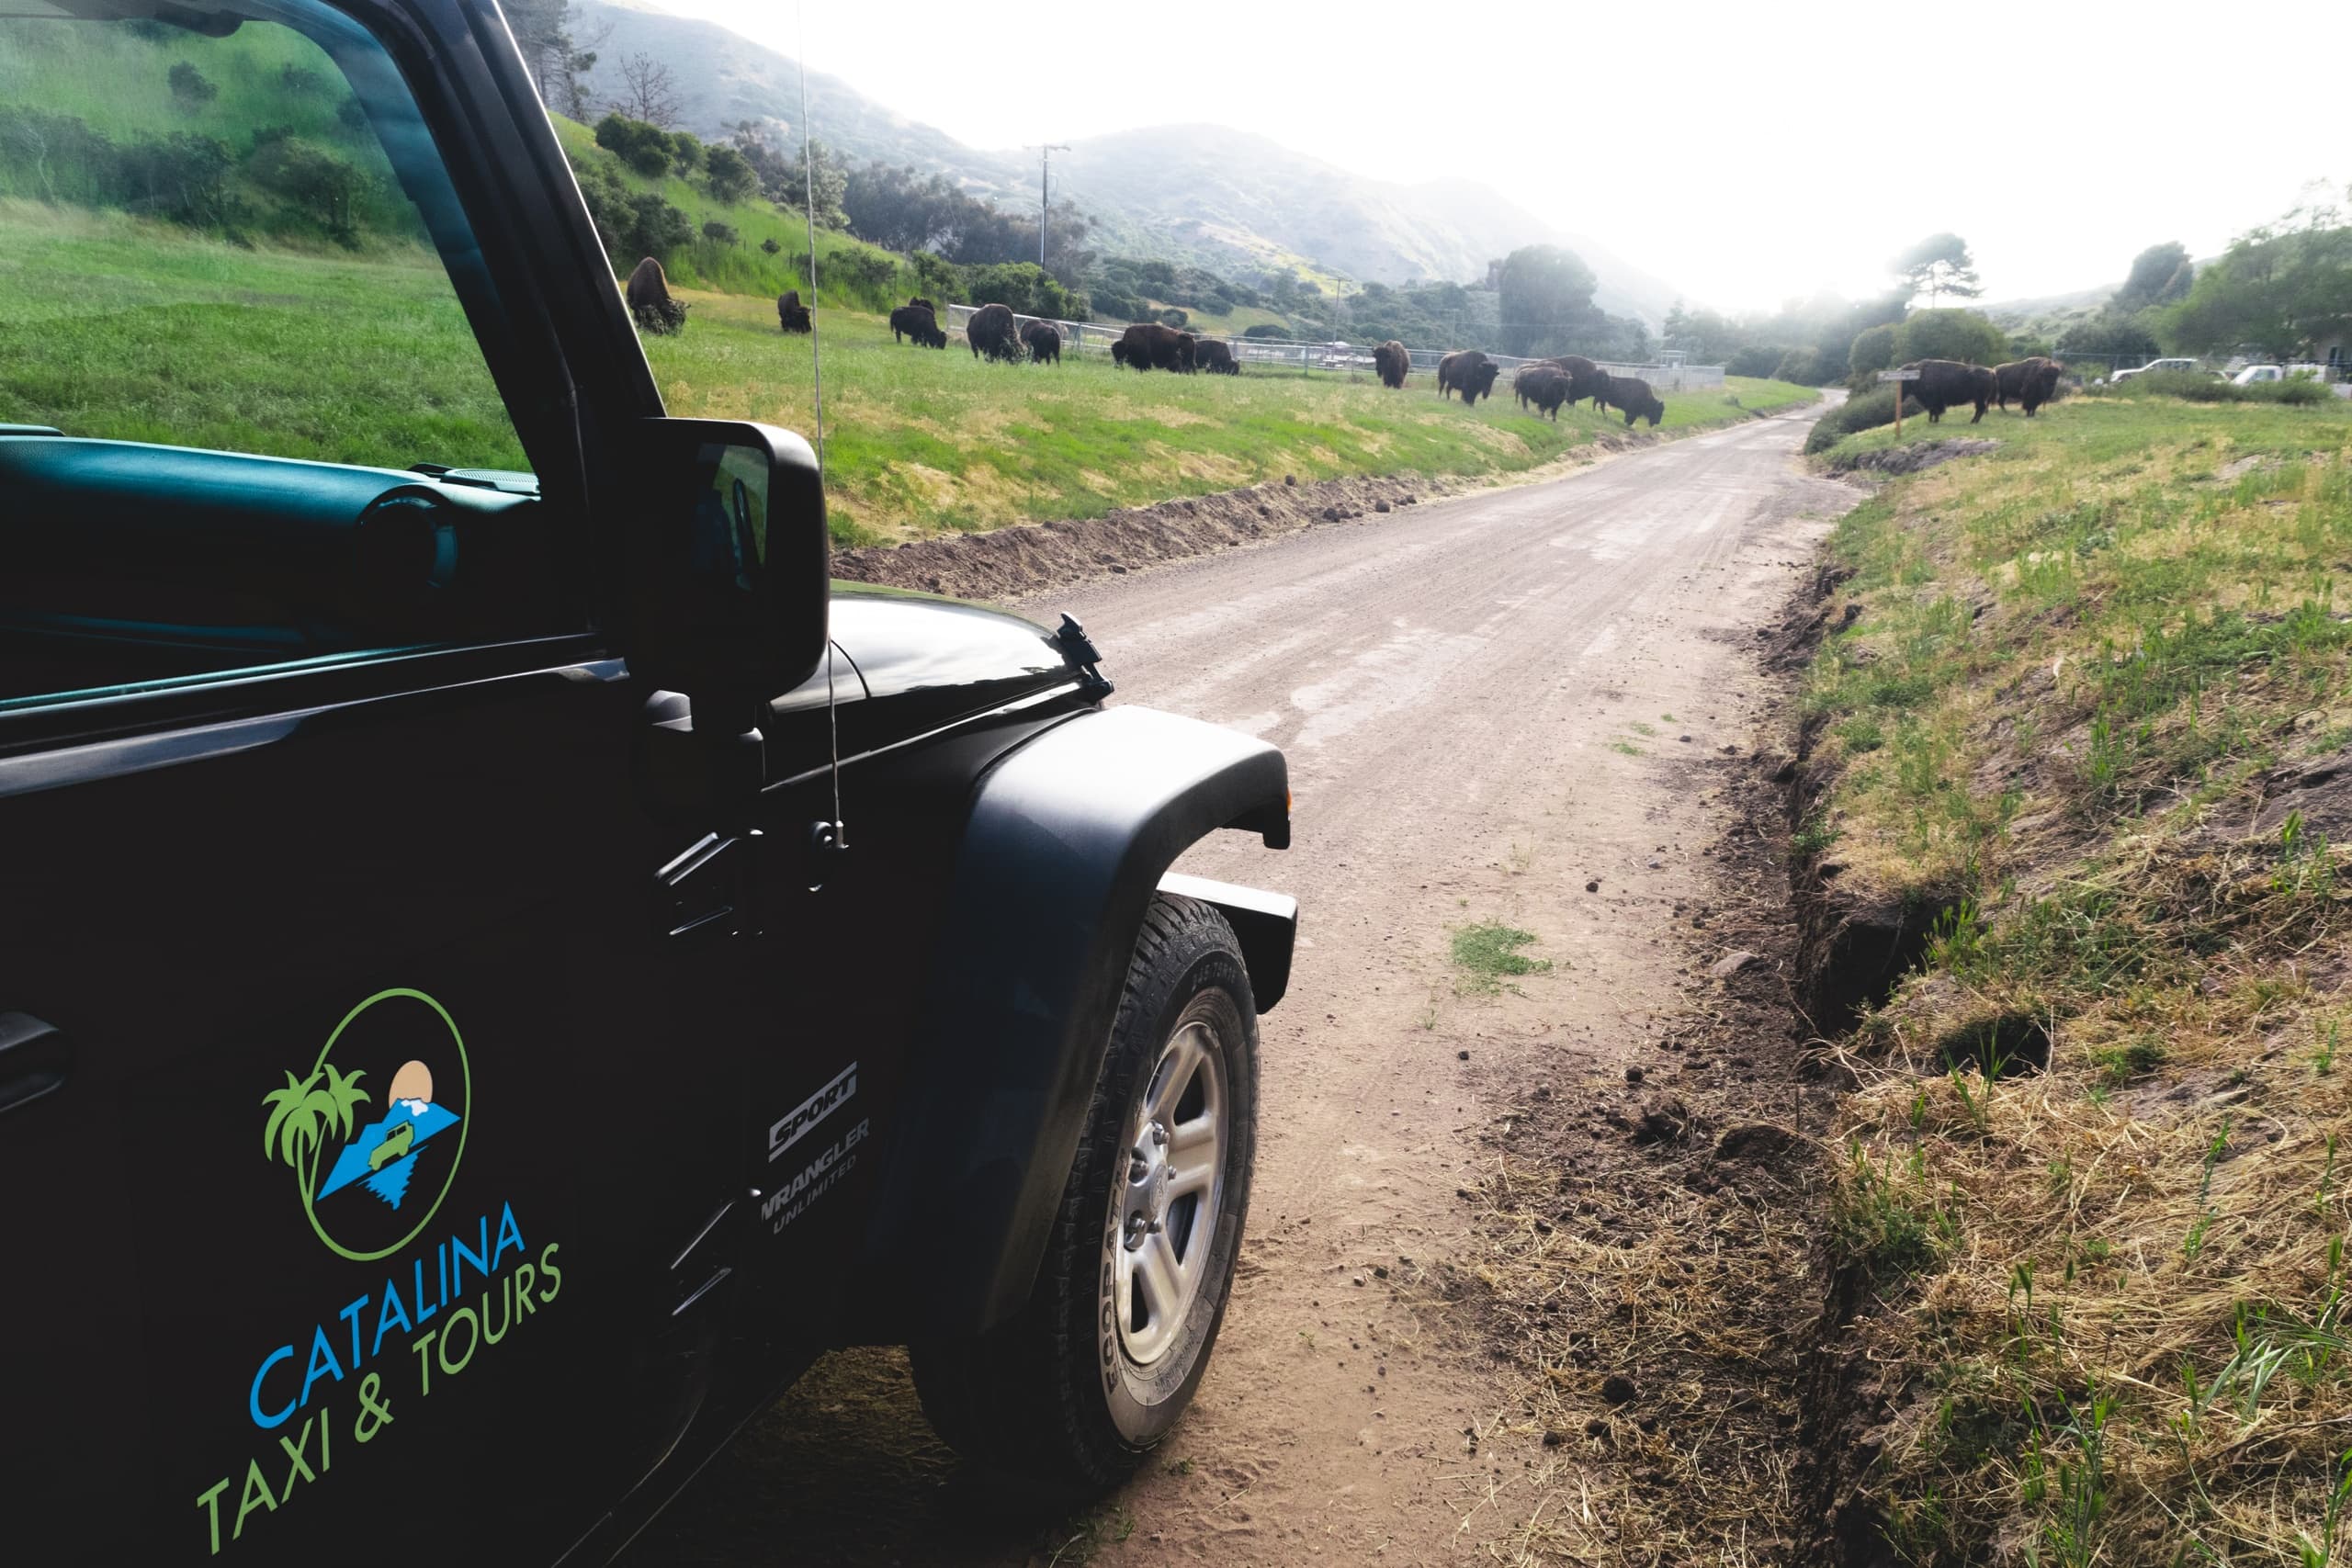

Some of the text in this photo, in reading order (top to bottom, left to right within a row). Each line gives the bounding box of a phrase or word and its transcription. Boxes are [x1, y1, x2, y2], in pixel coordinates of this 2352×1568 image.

[769, 1065, 857, 1158] SPORT
[774, 1155, 856, 1235] UNLIMITED
[250, 1200, 526, 1429] CATALINA
[197, 1243, 561, 1556] TAXI & TOURS
